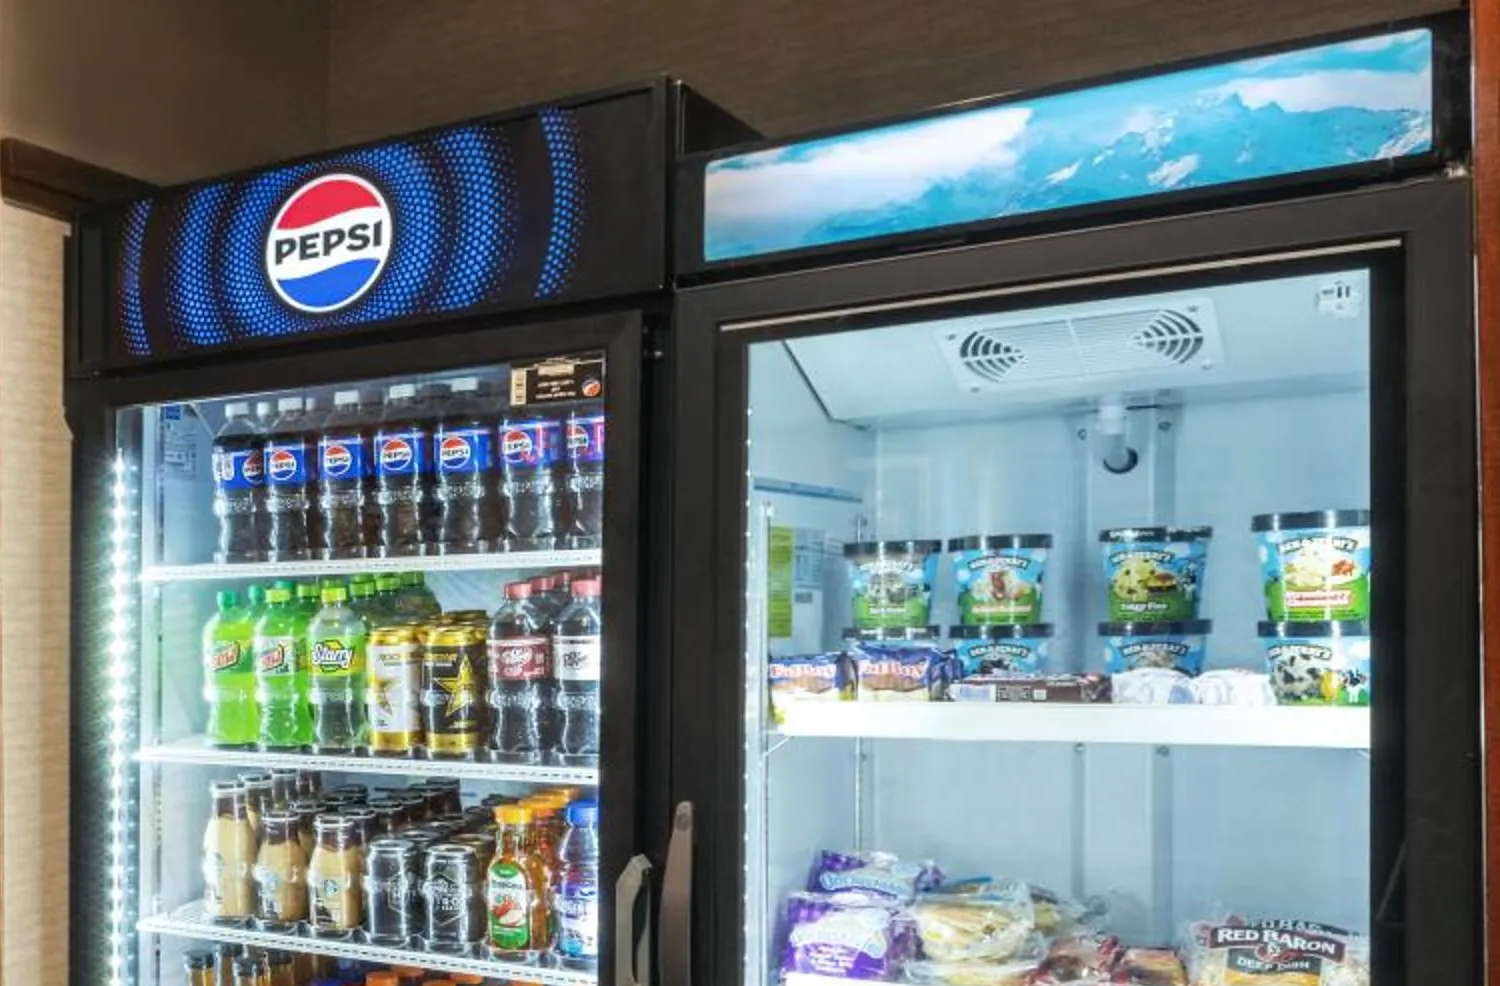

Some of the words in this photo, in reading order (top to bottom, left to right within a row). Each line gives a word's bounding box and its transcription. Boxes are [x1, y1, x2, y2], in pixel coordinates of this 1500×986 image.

[274, 220, 383, 265] PEPSI
[1217, 928, 1260, 943] RED
[1263, 929, 1336, 954] BARON
